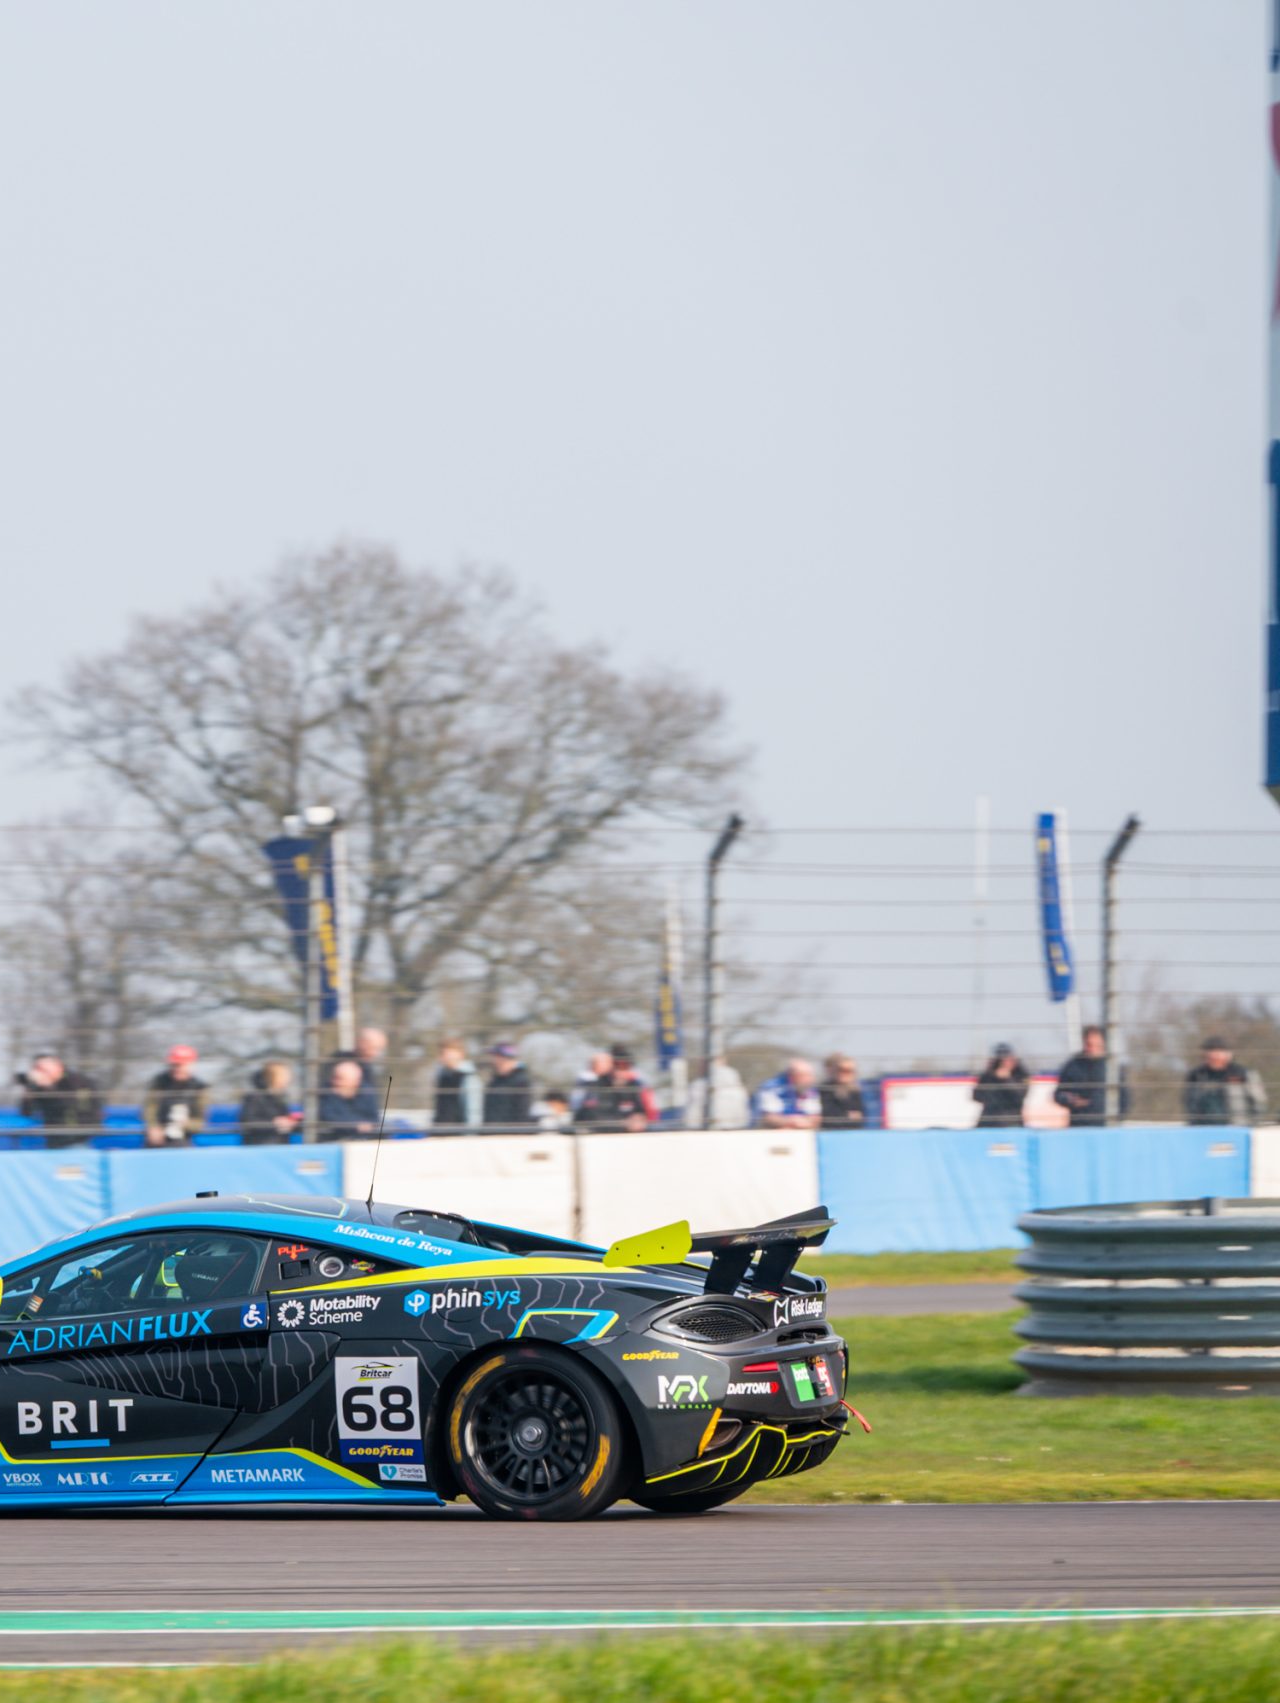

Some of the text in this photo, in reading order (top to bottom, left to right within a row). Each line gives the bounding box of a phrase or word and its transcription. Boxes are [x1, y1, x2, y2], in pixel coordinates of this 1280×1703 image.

[333, 1223, 452, 1256] Mishcon de Reya
[309, 1294, 381, 1312] Motability
[431, 1286, 521, 1315] phinsys
[309, 1310, 363, 1326] Scheme
[622, 1349, 679, 1361] GOODYEAR
[360, 1368, 393, 1378] Britcar
[726, 1381, 772, 1395] DAYTONA
[342, 1384, 415, 1432] 68
[17, 1398, 134, 1435] BRIT
[348, 1444, 415, 1458] GOODYEAR
[2, 1472, 41, 1483] VBOX
[210, 1467, 306, 1483] METAMARK
